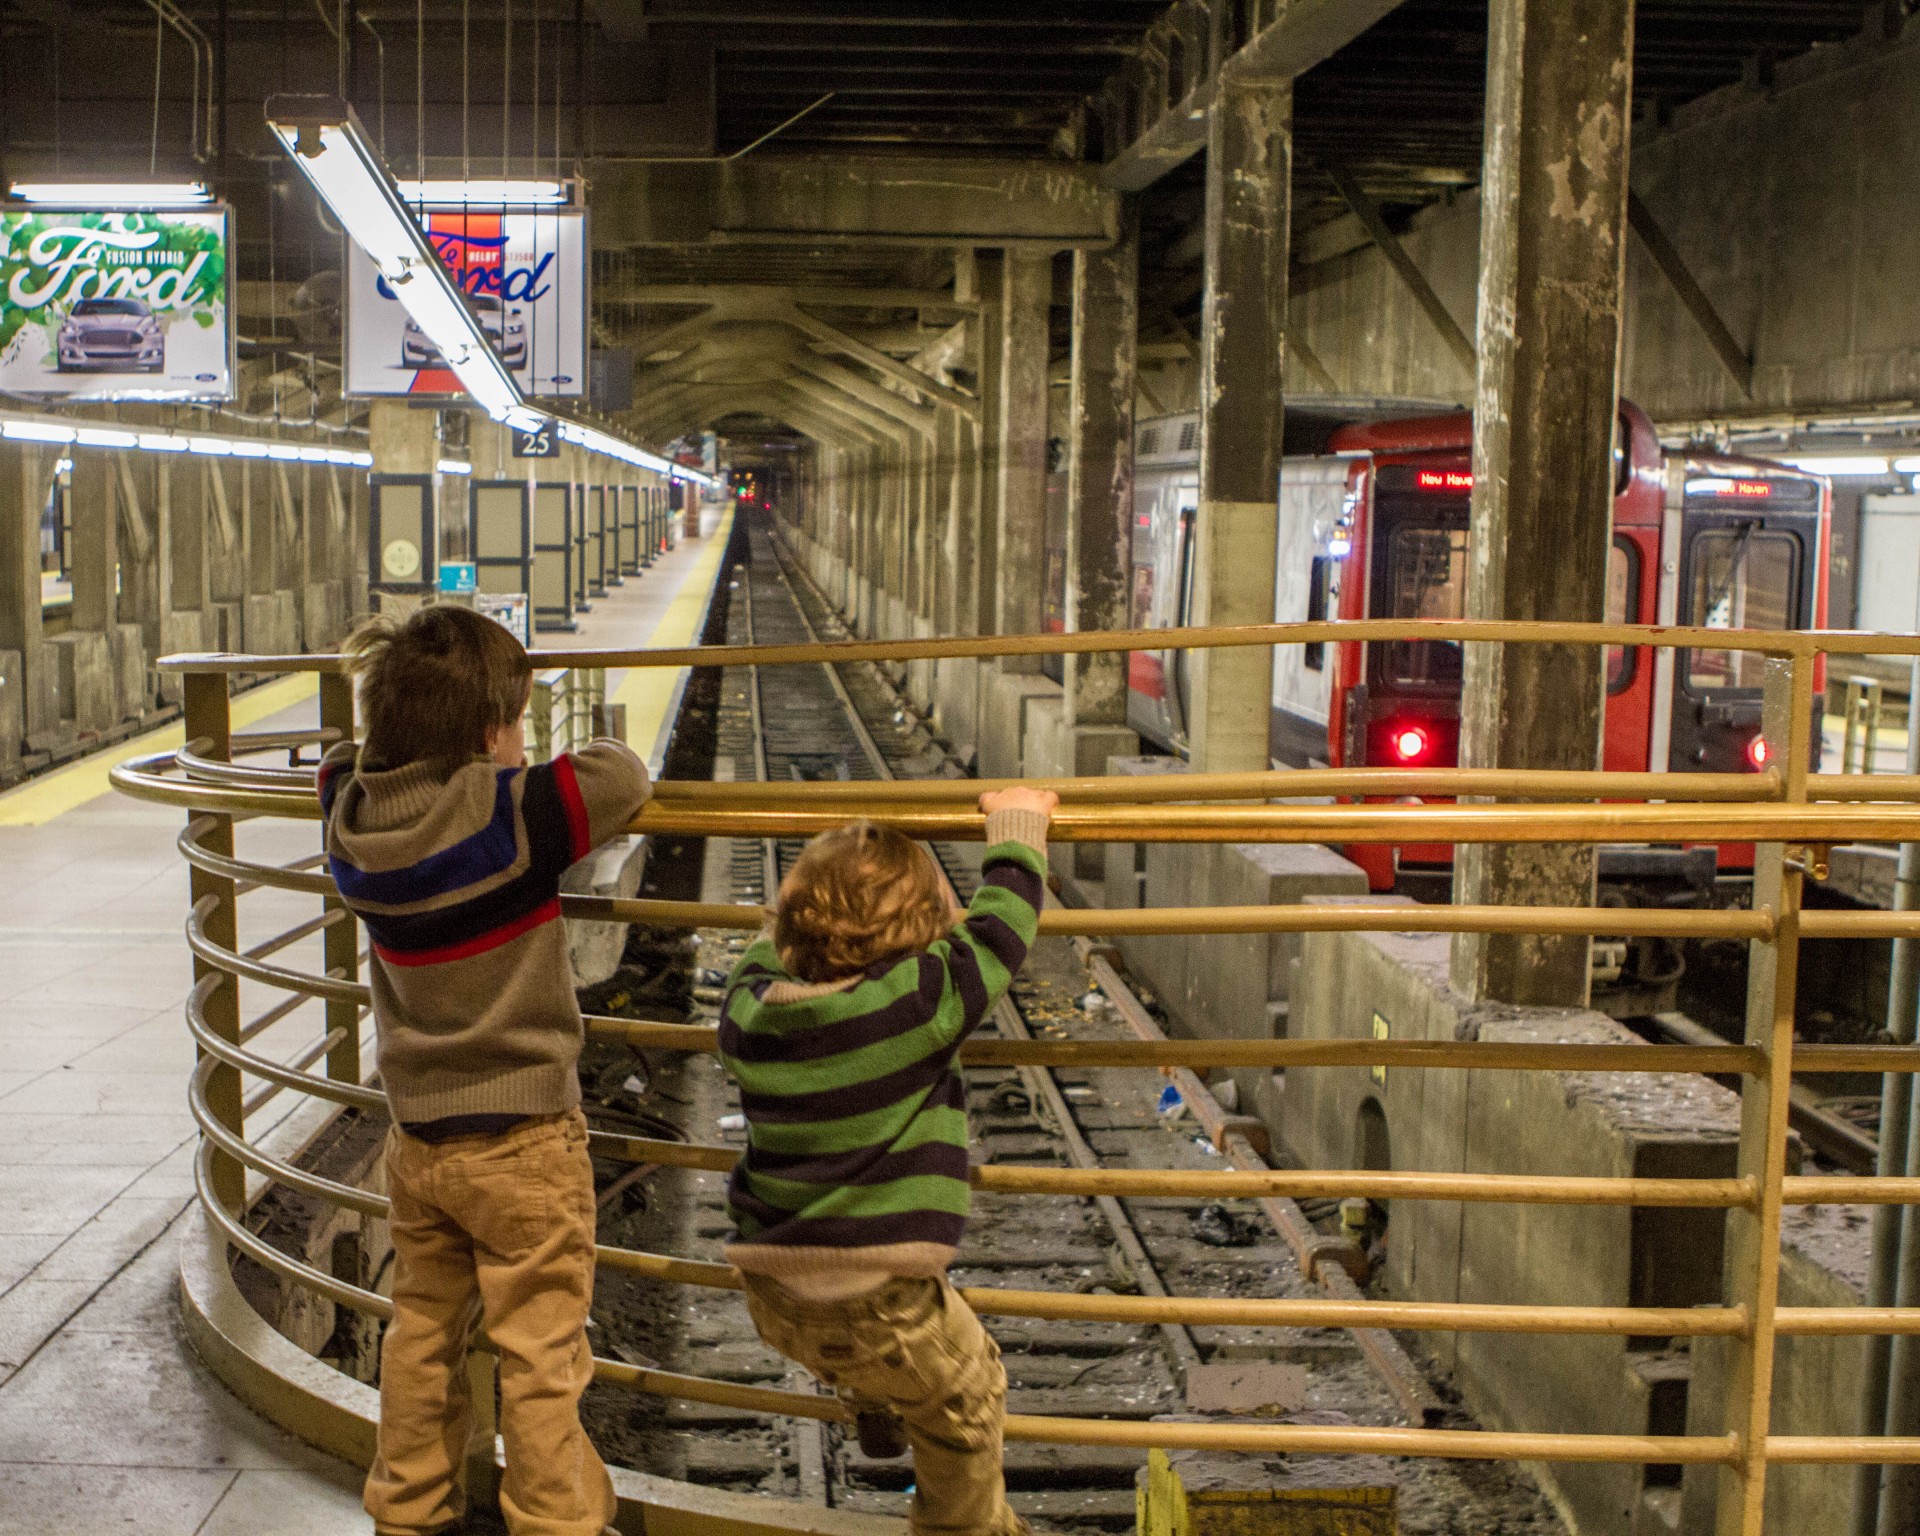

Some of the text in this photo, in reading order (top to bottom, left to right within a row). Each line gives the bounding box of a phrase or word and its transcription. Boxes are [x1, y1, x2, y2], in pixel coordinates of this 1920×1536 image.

[106, 250, 184, 265] FUSION HYBRID
[9, 226, 210, 309] Ford
[522, 432, 550, 455] 25
[1421, 473, 1474, 487] New Have
[1739, 482, 1769, 495] Haven
